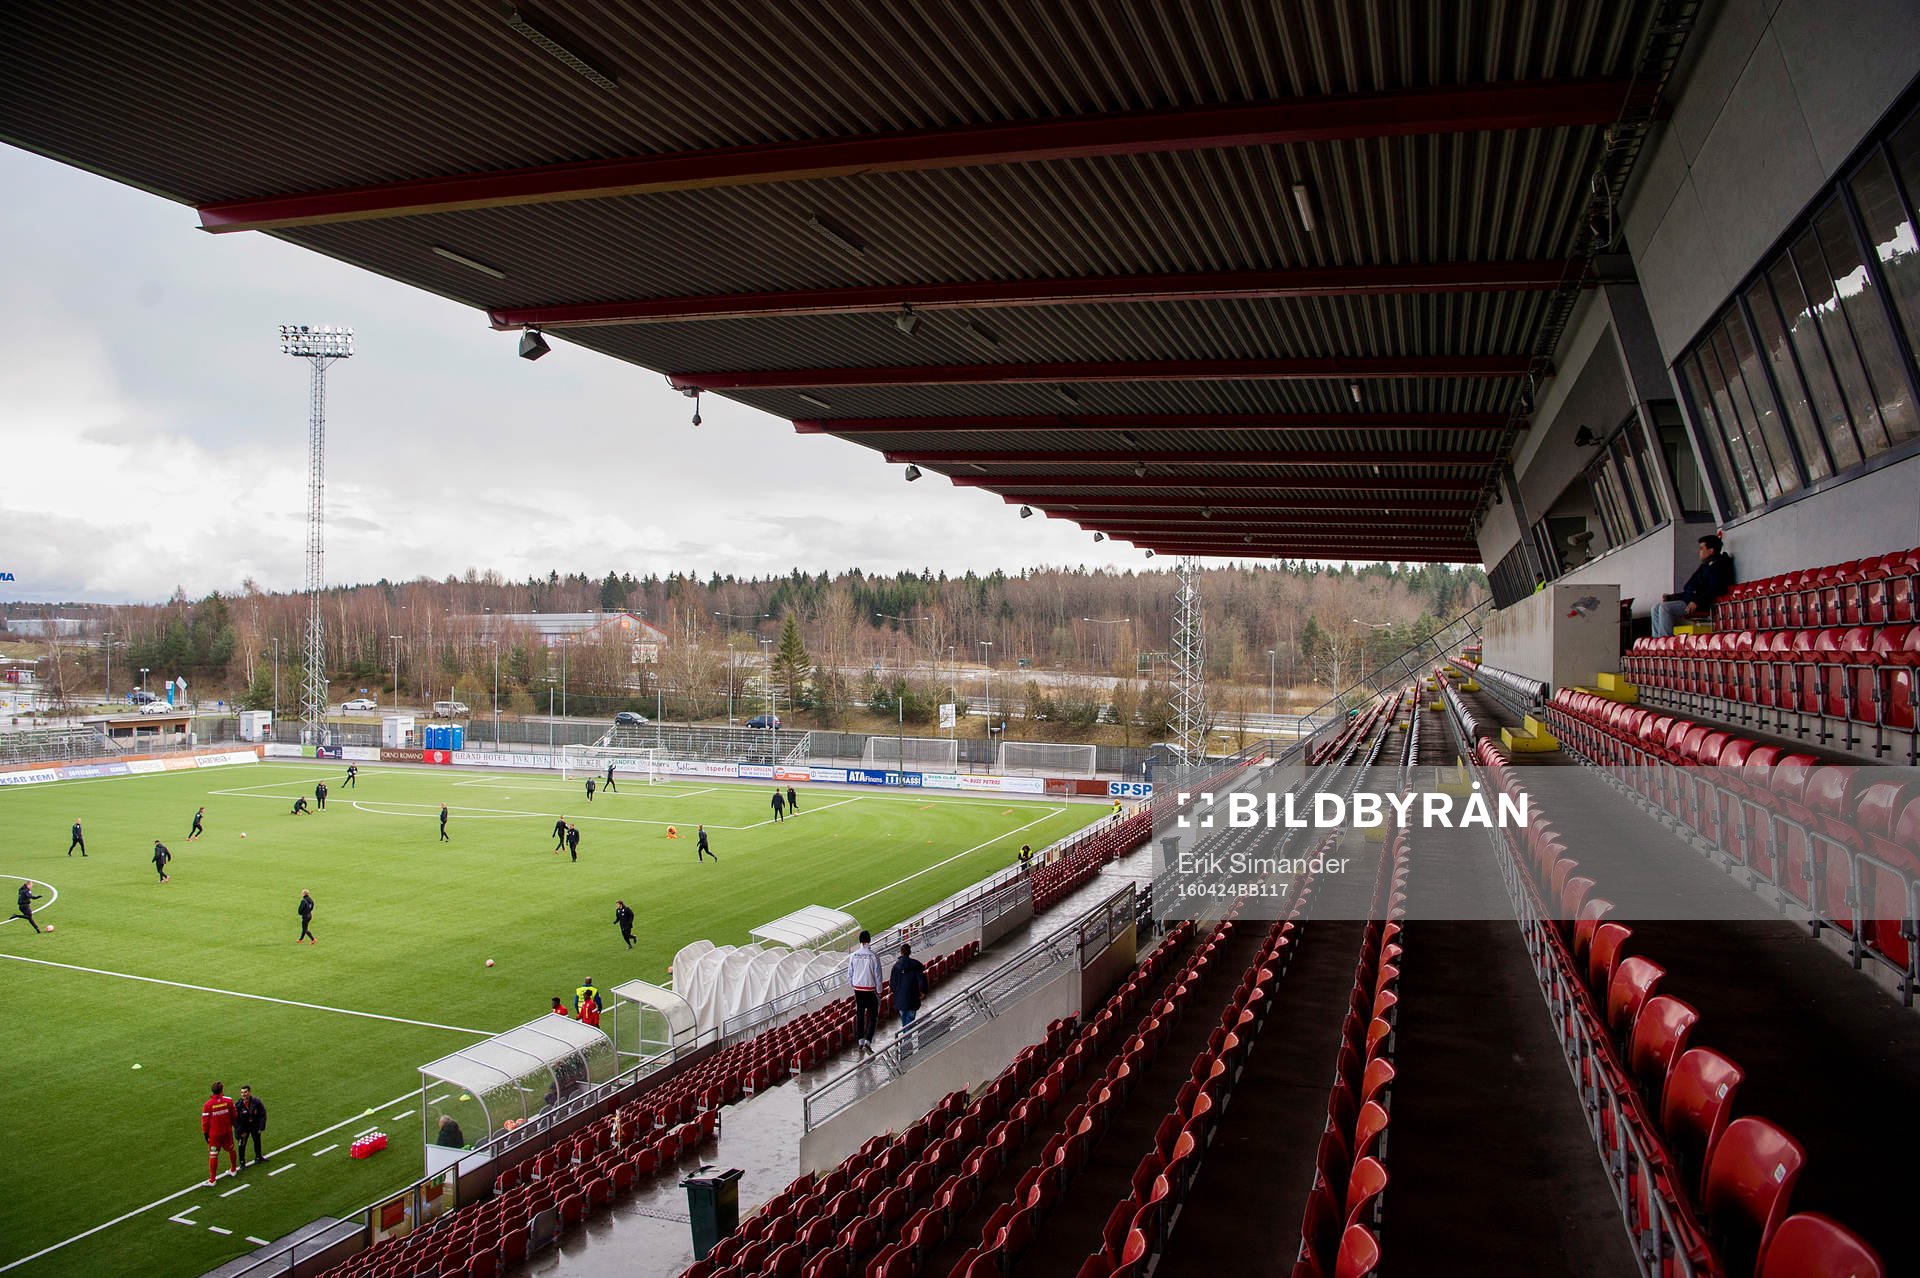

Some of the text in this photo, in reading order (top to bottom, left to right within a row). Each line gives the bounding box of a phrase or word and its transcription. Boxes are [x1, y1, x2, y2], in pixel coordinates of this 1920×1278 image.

[455, 752, 507, 762] GRAND HOTEL
[30, 773, 55, 783] KEMI
[849, 770, 866, 783] ATA
[865, 775, 883, 783] Finans
[1110, 783, 1153, 796] SP SP
